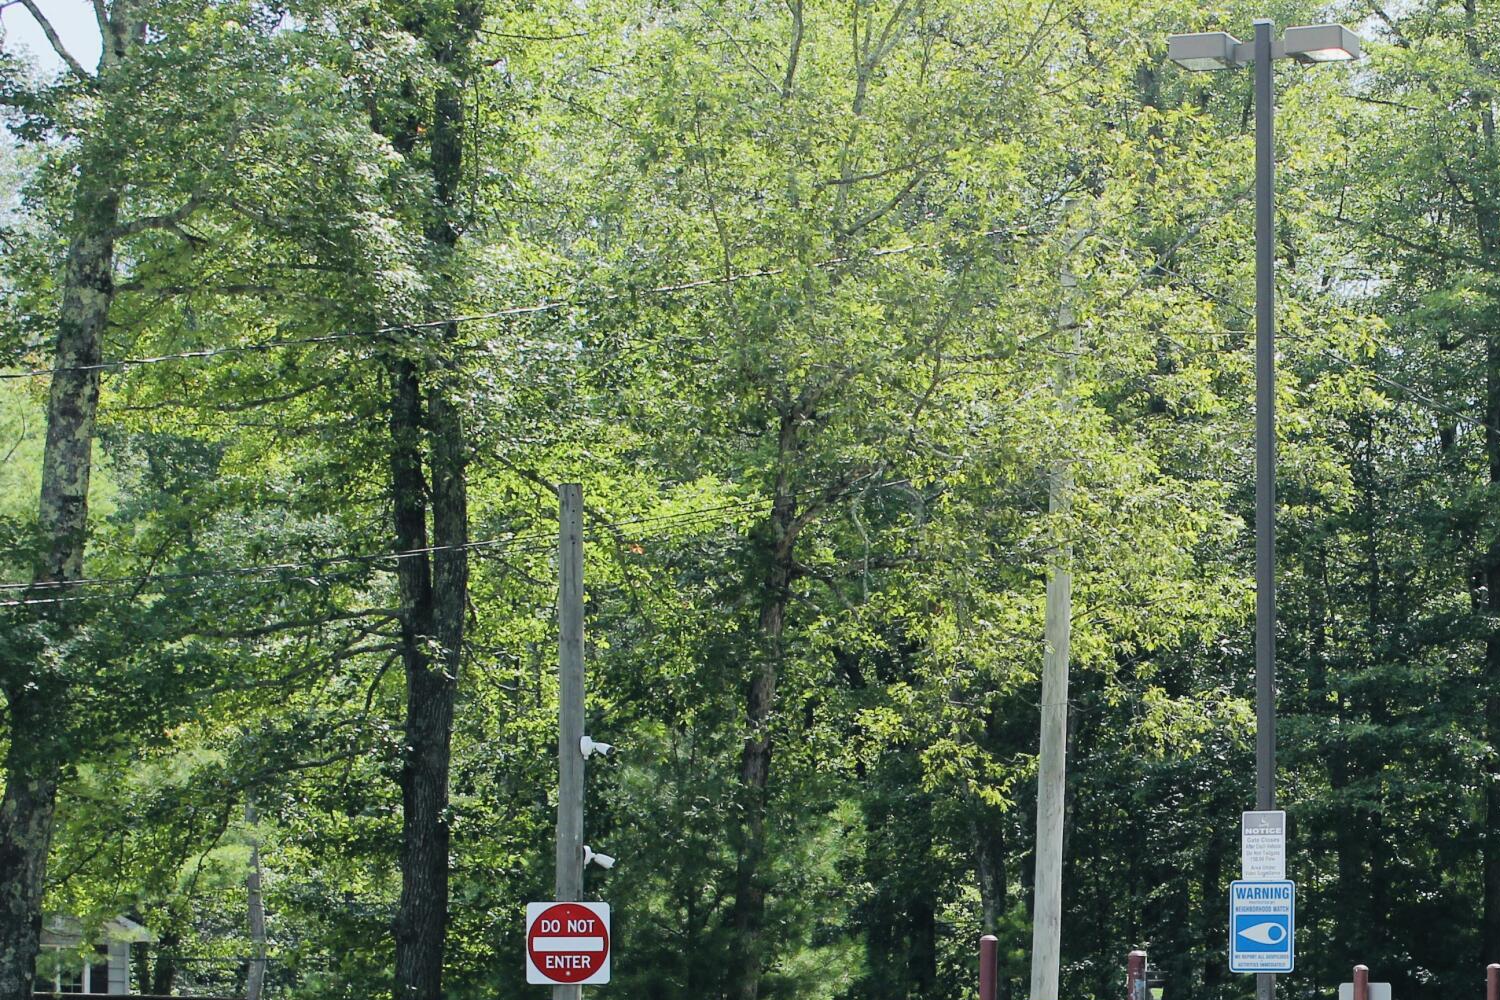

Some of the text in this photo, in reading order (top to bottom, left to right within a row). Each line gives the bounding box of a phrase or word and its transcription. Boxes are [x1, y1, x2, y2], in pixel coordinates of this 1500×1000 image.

[1236, 887, 1289, 899] WARNING
[541, 919, 595, 933] DO NOT
[546, 955, 591, 969] ENTER
